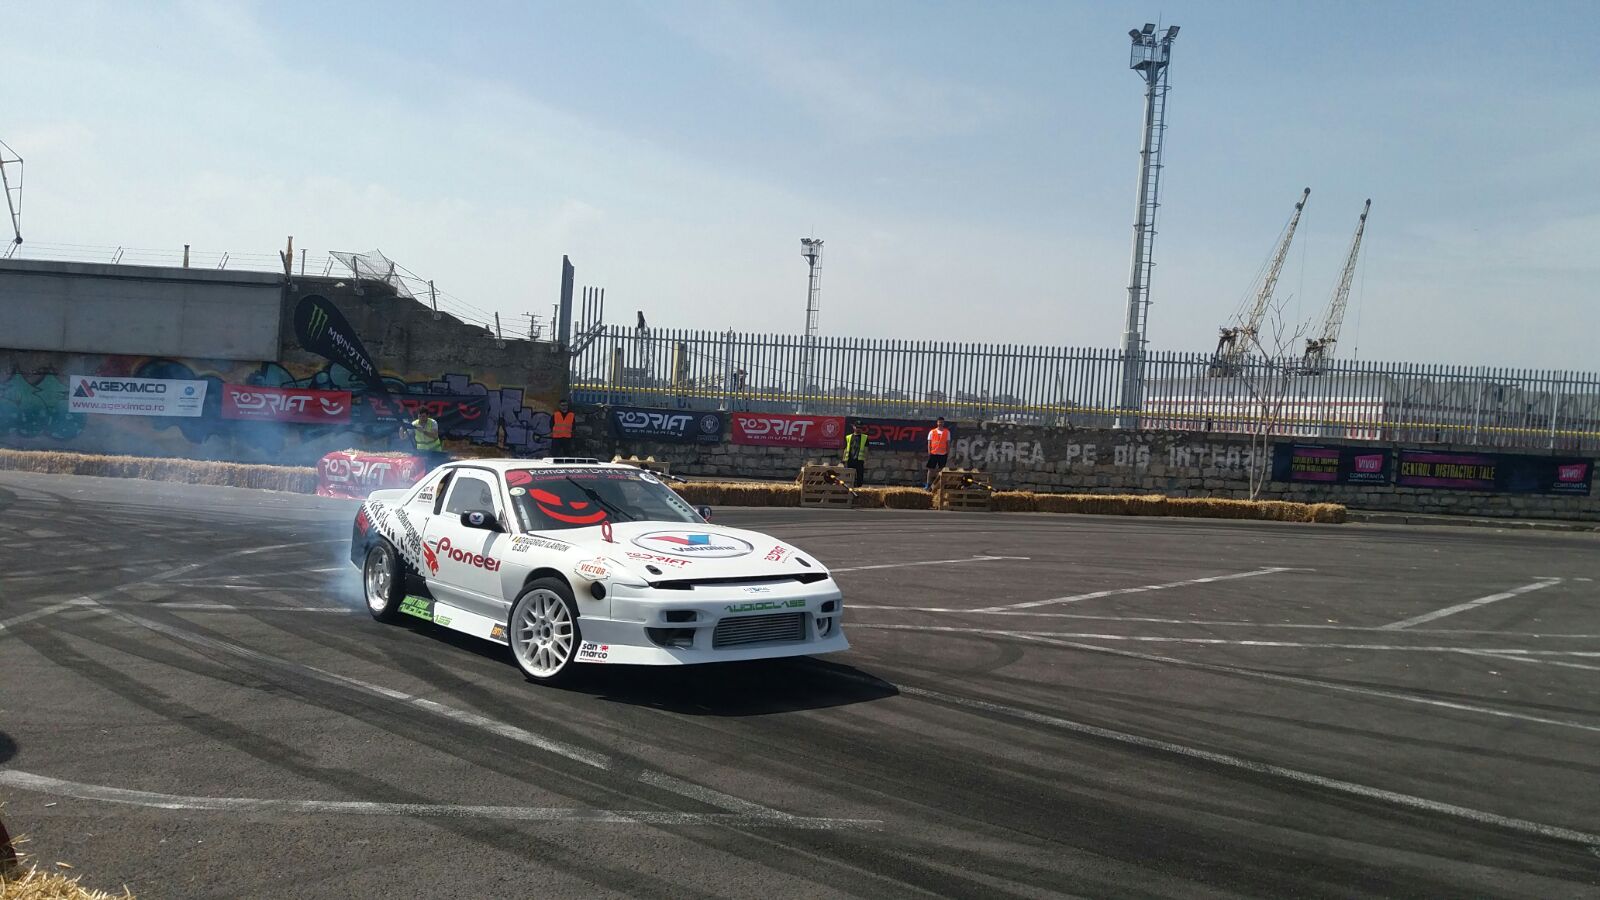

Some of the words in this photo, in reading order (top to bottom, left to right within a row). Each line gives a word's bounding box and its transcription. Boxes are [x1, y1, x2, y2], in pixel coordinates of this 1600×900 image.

[89, 381, 167, 394] AGEXIMCO
[72, 401, 165, 412] www.ageximco.ro
[230, 391, 313, 415] RODRIFT
[616, 411, 693, 431] RODRIFT
[738, 418, 815, 436] RODRIFT
[1066, 441, 1097, 466] PE
[1479, 466, 1496, 481] TALE
[436, 537, 501, 572] Pioneer
[672, 544, 737, 553] Valvoline
[580, 563, 606, 576] VECTOR
[582, 643, 598, 651] san
[580, 650, 608, 660] marco
